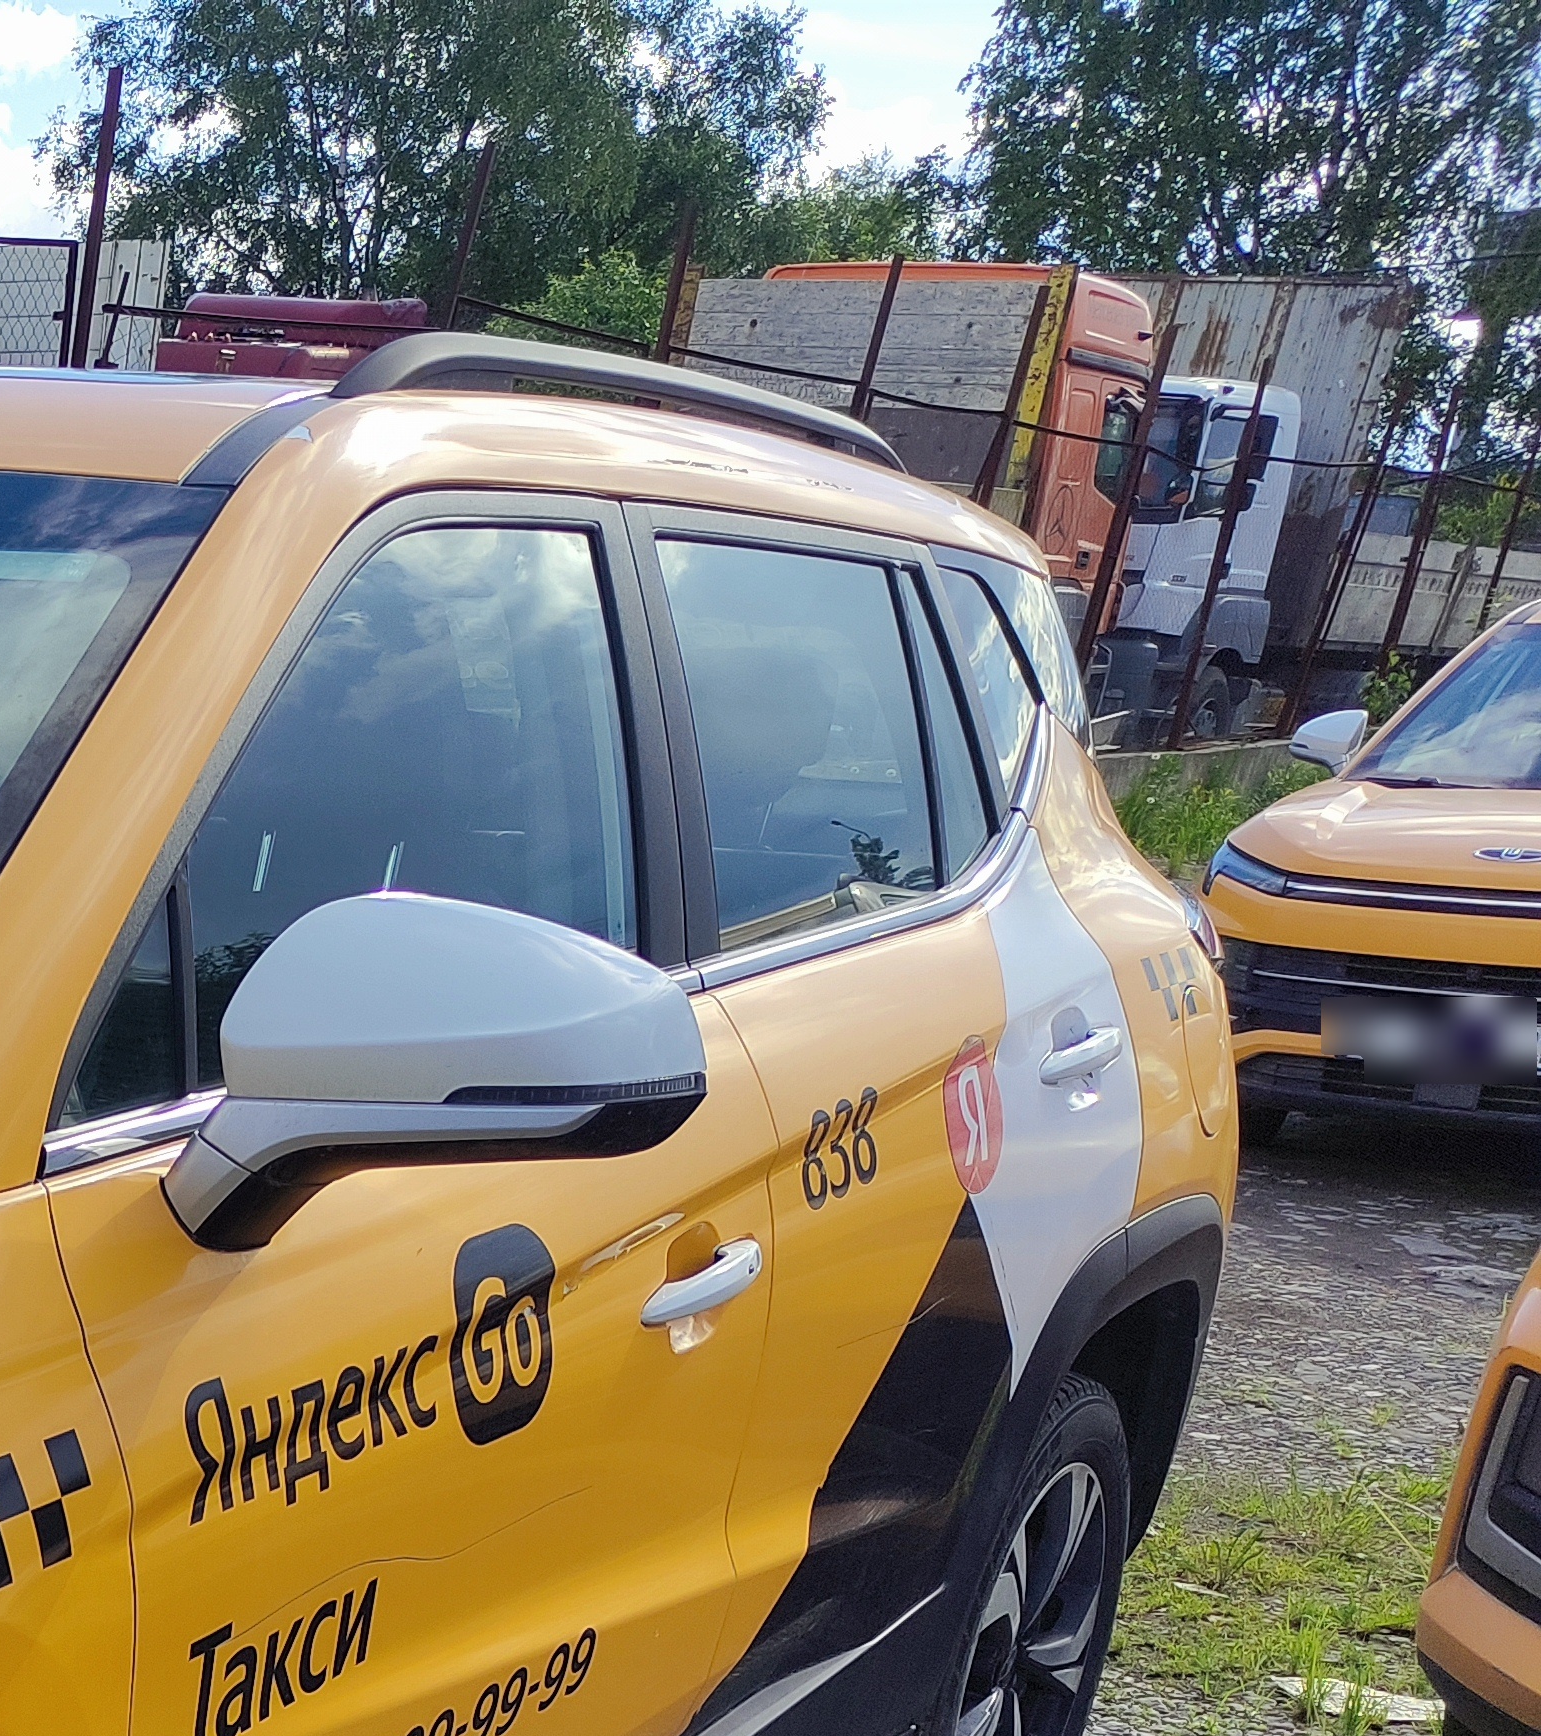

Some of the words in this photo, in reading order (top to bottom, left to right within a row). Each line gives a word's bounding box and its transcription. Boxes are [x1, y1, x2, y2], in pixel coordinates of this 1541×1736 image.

[802, 1087, 878, 1210] 838
[958, 1065, 988, 1167] Я
[184, 1335, 439, 1526] Яндекс
[462, 1277, 541, 1404] Go
